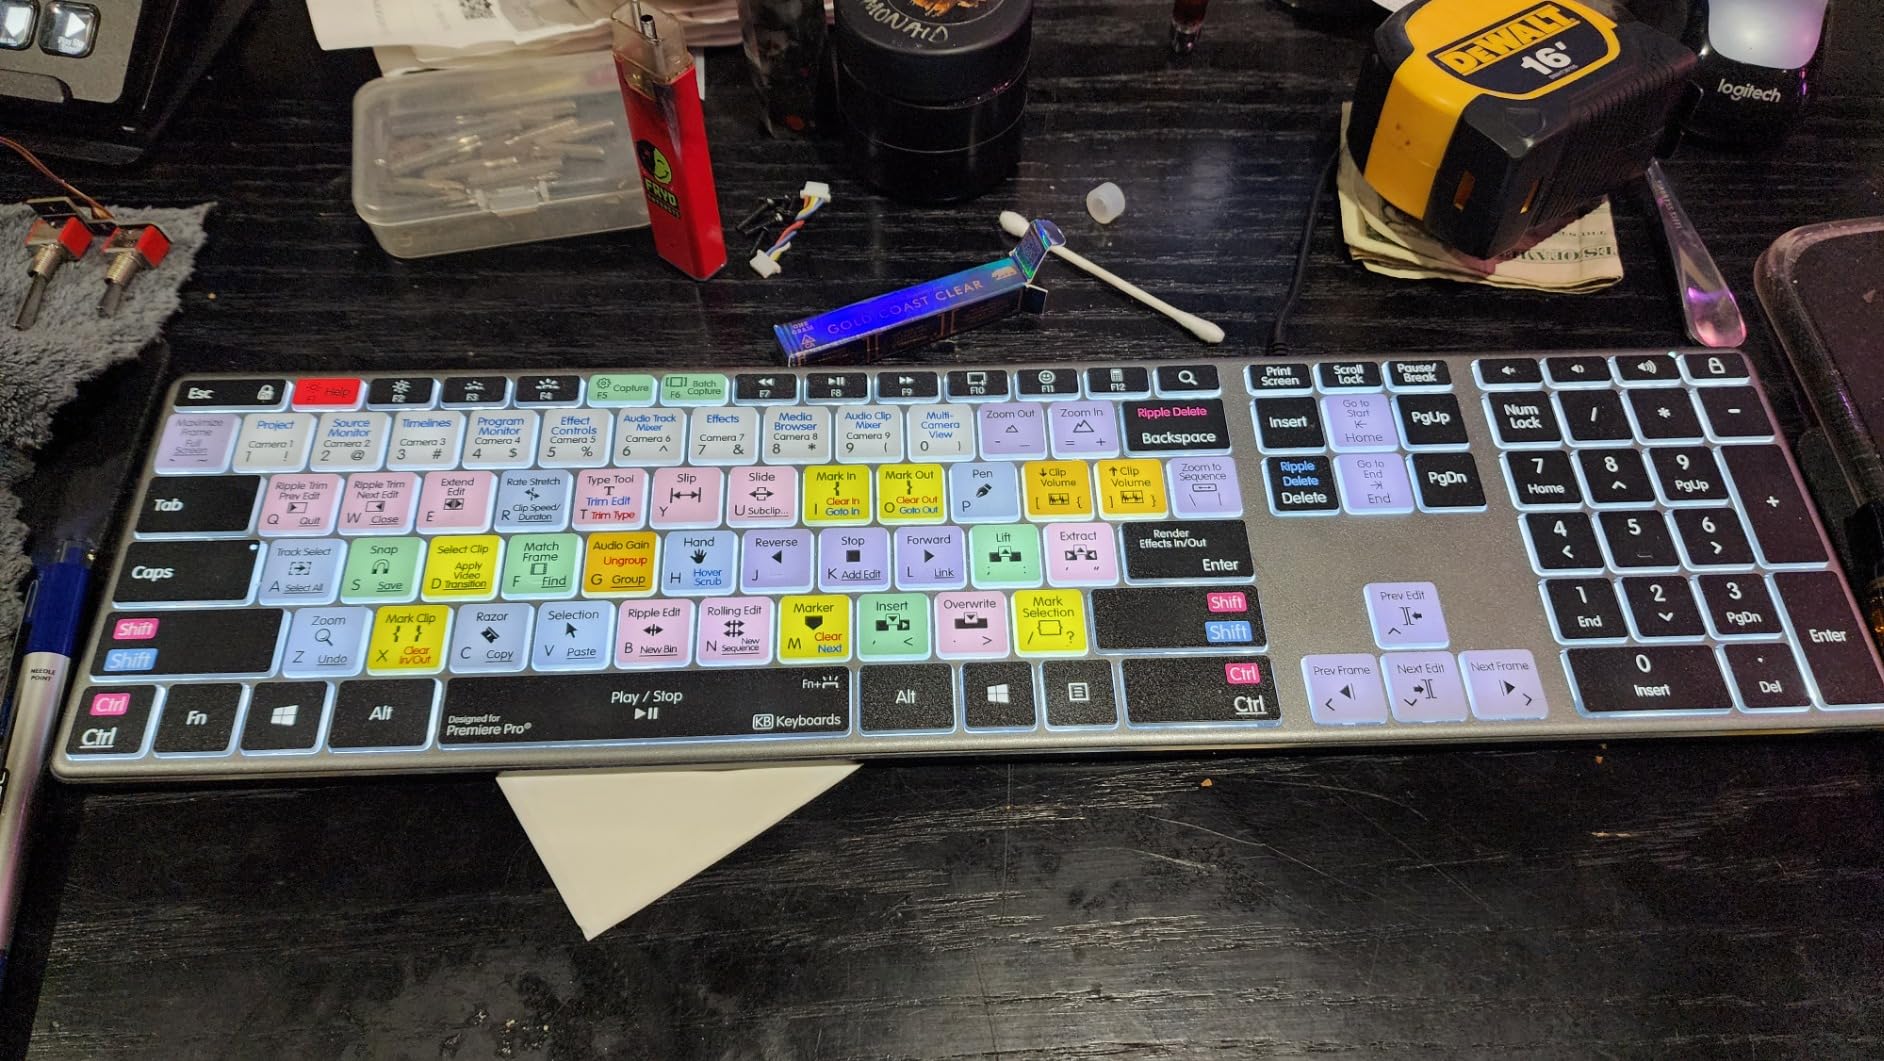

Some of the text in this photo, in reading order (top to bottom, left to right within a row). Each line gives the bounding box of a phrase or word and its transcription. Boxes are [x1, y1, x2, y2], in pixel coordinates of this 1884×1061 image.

[1444, 5, 1577, 74] DEWALT
[1521, 41, 1571, 75] 16'
[1717, 79, 1781, 102] logitech
[828, 280, 983, 334] GOLD COAST CLEAR
[1266, 367, 1291, 376] Print
[1333, 365, 1364, 374] Scroll
[1397, 363, 1436, 372] Pause/
[1261, 376, 1300, 385] Screen
[1339, 374, 1364, 384] Lock
[1403, 373, 1436, 382] Break
[187, 387, 214, 399] Esc
[613, 384, 648, 392] Capture
[688, 388, 721, 396] Capture
[326, 388, 349, 399] Help
[1137, 407, 1207, 417] Ripple Delete
[1347, 408, 1369, 417] Start
[1505, 404, 1539, 415] Num
[707, 414, 739, 424] Effects
[779, 412, 812, 421] Media
[926, 411, 953, 420] Multi-
[1412, 411, 1449, 424] PgUp
[257, 420, 294, 429] Project
[333, 419, 370, 427] Source
[403, 419, 451, 427] Timelines
[478, 418, 524, 427] Program
[561, 417, 590, 425] Effect
[856, 421, 881, 430] Mixer
[921, 421, 960, 429] Camera
[1269, 416, 1307, 428] Insert
[1509, 416, 1542, 429] Lock
[479, 427, 520, 435] Monitor
[551, 427, 596, 435] Controls
[774, 422, 817, 431] Browser
[328, 428, 371, 437] Monitor
[929, 430, 953, 439] View
[1346, 433, 1383, 442] Home
[1142, 432, 1216, 445] Backspace
[1280, 461, 1315, 473] Ripple
[1531, 457, 1544, 473] 7
[1604, 457, 1618, 472] 8
[1677, 455, 1689, 470] 9
[749, 472, 775, 481] Slide
[1120, 467, 1139, 476] Clip
[1179, 472, 1226, 481] Sequence
[677, 473, 696, 483] Slip
[1041, 478, 1076, 486] Volume
[1112, 478, 1150, 487] Volume
[1283, 475, 1319, 486] Delete
[1429, 471, 1467, 485] PgDn
[1527, 483, 1565, 494] Home
[1676, 480, 1709, 492] PgUp
[1282, 492, 1327, 505] Delete
[1368, 494, 1391, 504] End
[155, 499, 183, 510] Tab
[371, 515, 398, 524] Close
[1703, 516, 1715, 532] 6
[1554, 520, 1567, 537] 4
[1628, 518, 1641, 534] 5
[1060, 532, 1097, 541] Extract
[1154, 529, 1189, 537] Render
[684, 538, 714, 547] Hand
[755, 538, 798, 547] Reverse
[841, 537, 865, 546] Stop
[907, 535, 950, 545] Forward
[1140, 538, 1206, 548] Effects In/Out
[370, 545, 398, 554] Snap
[524, 542, 559, 551] Match
[593, 541, 650, 550] Audio Gain
[523, 552, 558, 561] Frame
[604, 557, 647, 566] Ungroup
[455, 562, 482, 570] Apply
[1203, 559, 1239, 571] Enter
[131, 566, 174, 581] Caps
[454, 571, 480, 579] Video
[694, 569, 722, 577] Hover
[934, 568, 954, 577] Link
[445, 580, 487, 588] Transition
[542, 576, 566, 586] Find
[612, 575, 645, 585] Group
[694, 577, 722, 586] Scrub
[378, 582, 402, 590] Save
[1727, 582, 1742, 599] 3
[1575, 586, 1588, 603] 1
[1650, 585, 1666, 602] 2
[876, 601, 908, 611] Insert
[944, 600, 996, 609] Overwrite
[1033, 597, 1063, 606] Mark
[1211, 597, 1242, 609] Shift
[793, 603, 834, 612] Marker
[476, 612, 509, 621] Razor
[548, 611, 599, 620] Selection
[1023, 608, 1074, 618] Selection
[312, 616, 345, 625] Zoom
[386, 614, 436, 624] Mark Clip
[1578, 616, 1602, 627] End
[1727, 612, 1761, 626] PgDn
[119, 622, 153, 635] Shift
[1209, 626, 1249, 640] Shift
[815, 632, 842, 641] Clear
[1810, 629, 1846, 643] Enter
[404, 646, 430, 655] Clear
[567, 648, 596, 657] Paste
[722, 644, 759, 652] Sequence
[818, 645, 842, 653] Next
[318, 654, 347, 664] Undo
[487, 650, 513, 660] Copy
[110, 653, 150, 668] Shift
[400, 656, 431, 665] In/Out
[1636, 655, 1651, 672] 0
[1472, 662, 1529, 672] Next Frame
[1230, 668, 1256, 681] Ctrl
[1634, 684, 1670, 697] Insert
[1759, 681, 1782, 693] Del
[611, 691, 639, 704] Play
[654, 691, 682, 703] Stop
[896, 690, 915, 704] Alt
[95, 698, 126, 712] Ctrl
[1234, 696, 1264, 712] Ctrl
[187, 711, 207, 725] Fn
[369, 706, 394, 720] Alt
[755, 715, 841, 728] KB Keyboards
[447, 724, 500, 736] Premiere
[82, 727, 117, 745] Ctrl
